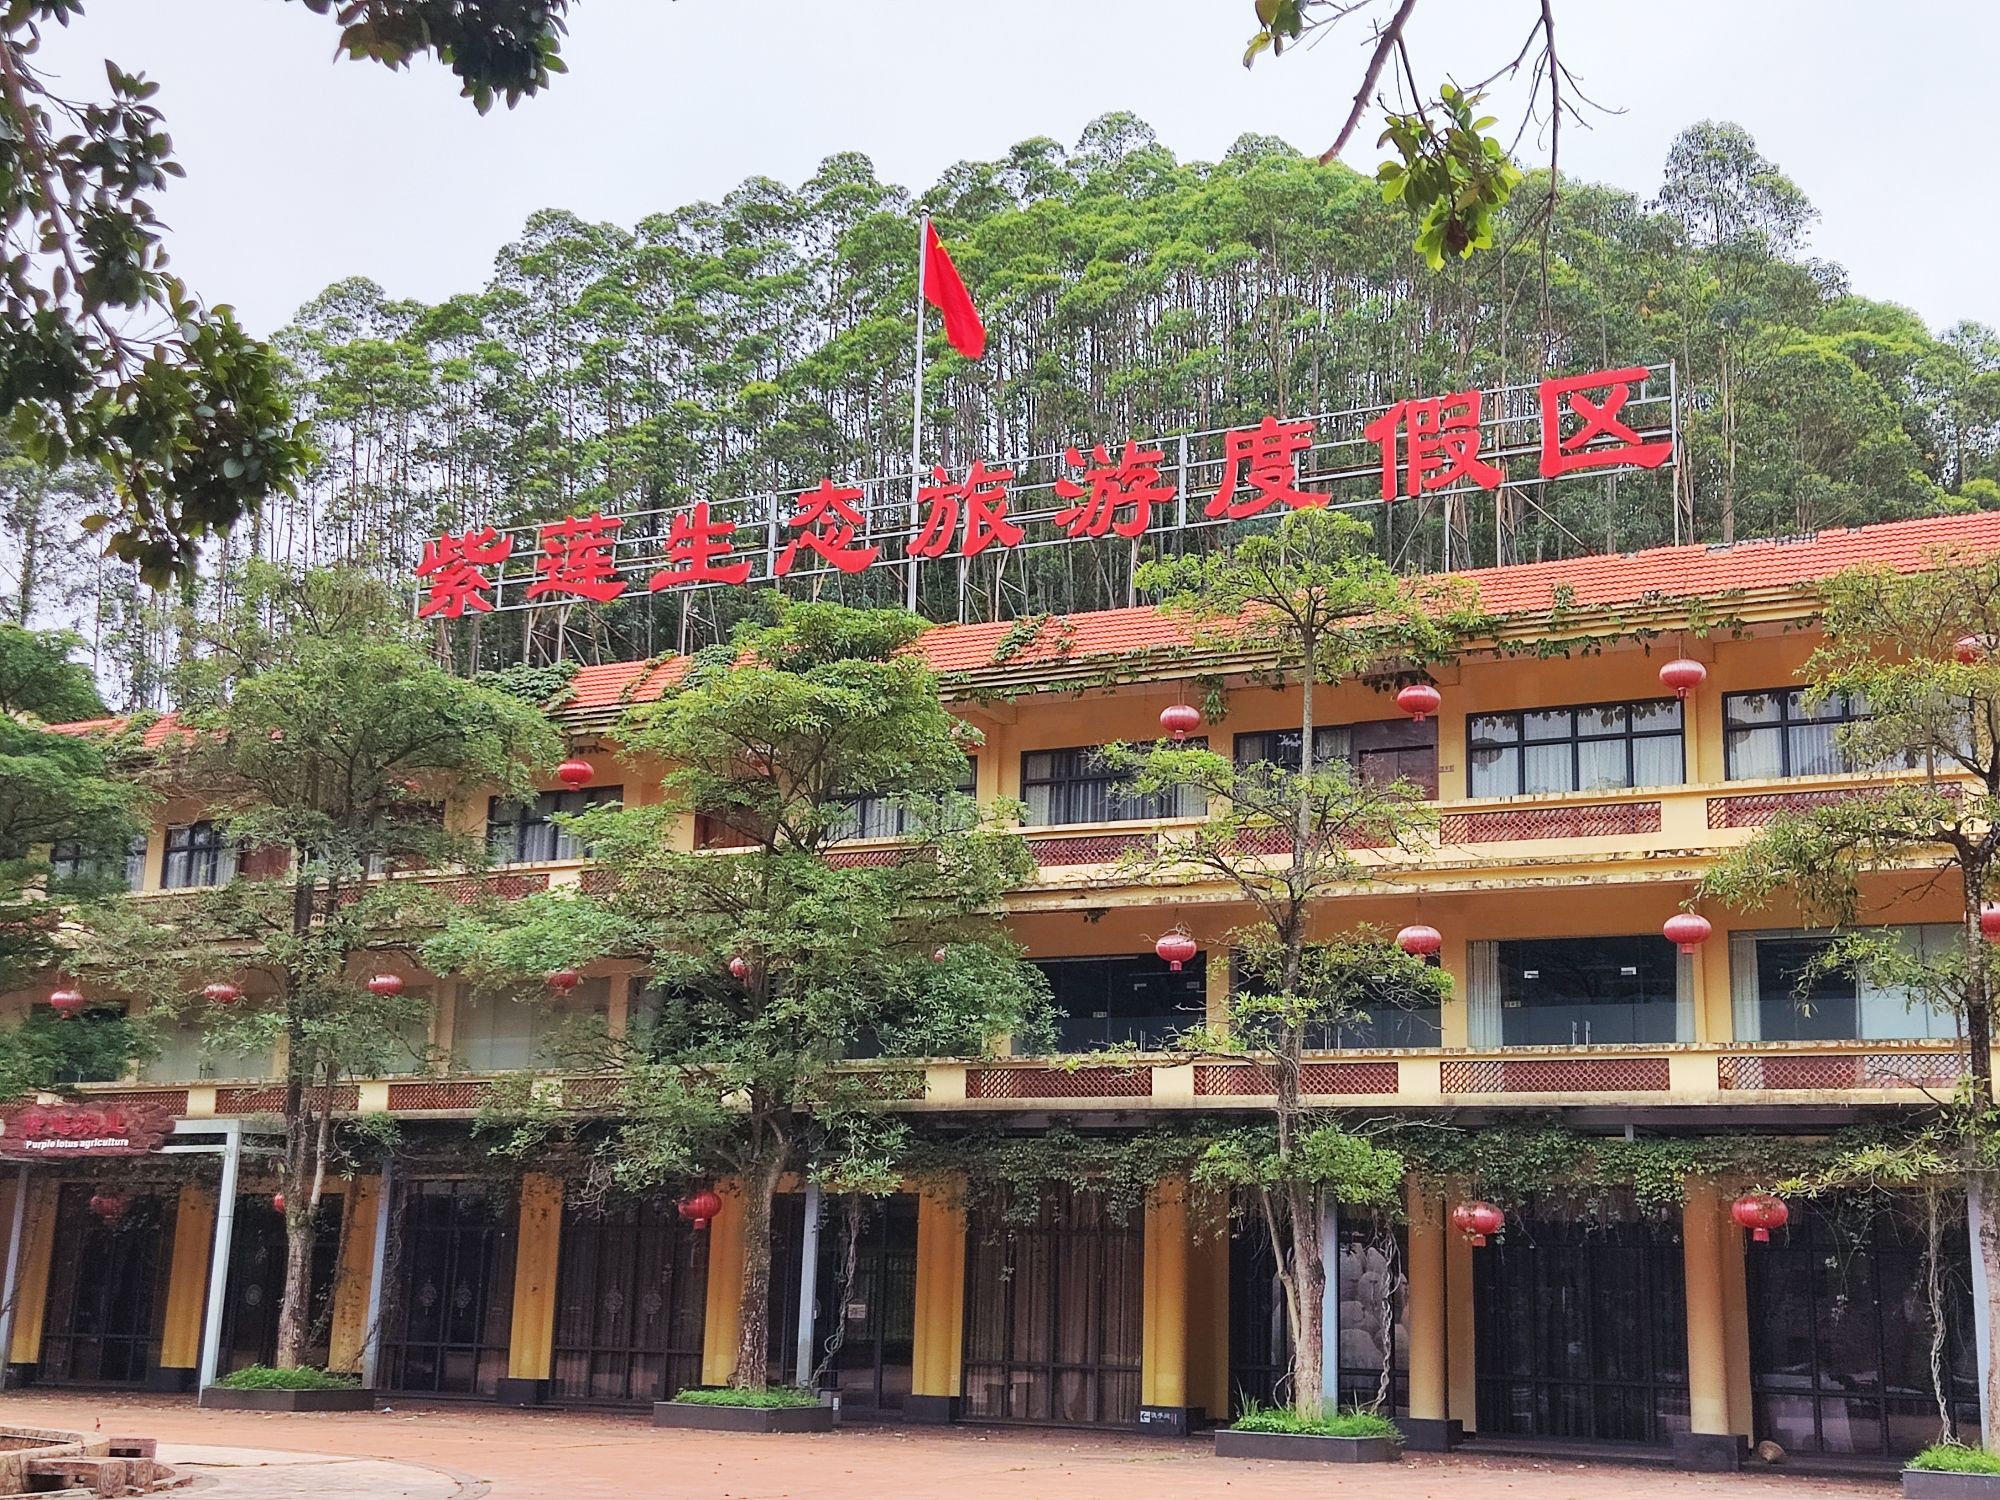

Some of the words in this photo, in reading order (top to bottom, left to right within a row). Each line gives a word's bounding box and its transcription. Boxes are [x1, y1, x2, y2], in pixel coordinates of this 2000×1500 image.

[416, 366, 1673, 619] 紫莲生态旅游度假区
[26, 1140, 56, 1149] Purple
[57, 1139, 79, 1148] lotus
[80, 1138, 129, 1149] agriculture
